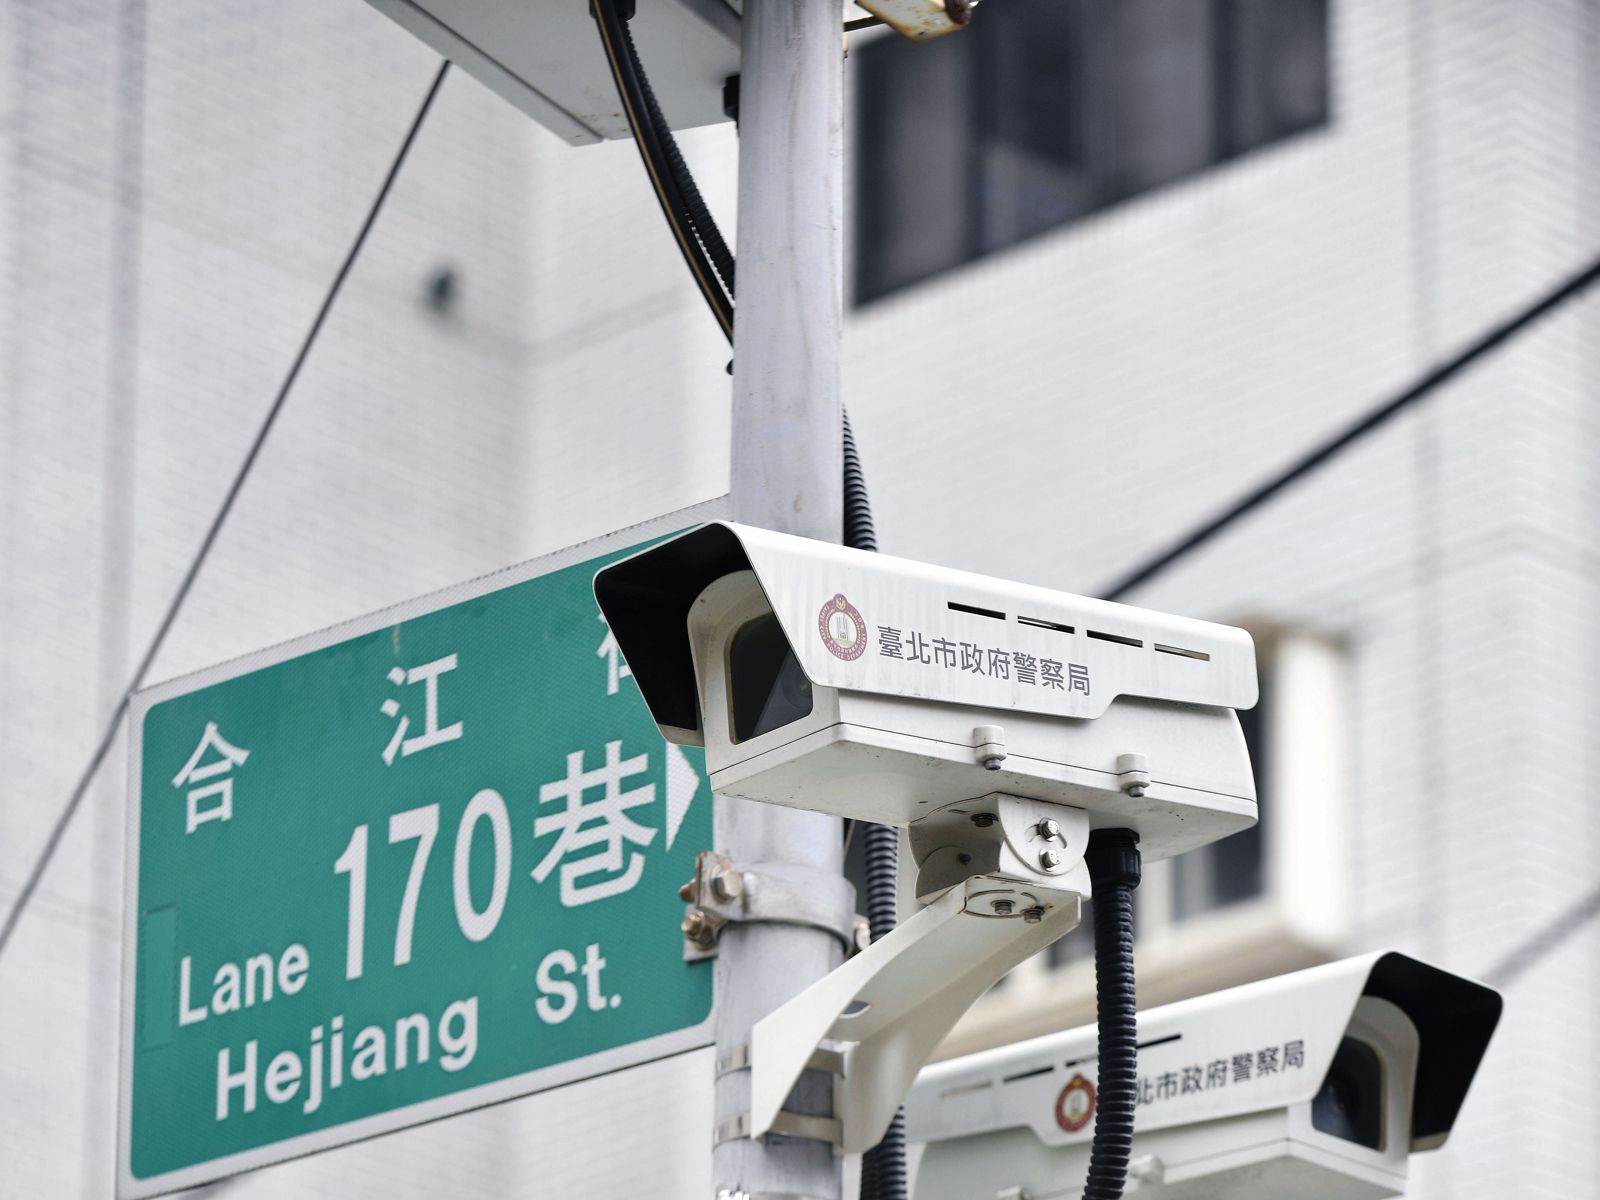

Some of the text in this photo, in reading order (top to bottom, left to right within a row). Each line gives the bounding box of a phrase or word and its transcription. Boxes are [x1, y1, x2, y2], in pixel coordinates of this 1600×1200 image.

[877, 625, 1091, 697] 臺北市政府警察局
[178, 942, 310, 1027] Lane
[215, 942, 623, 1121] Hejiang St.
